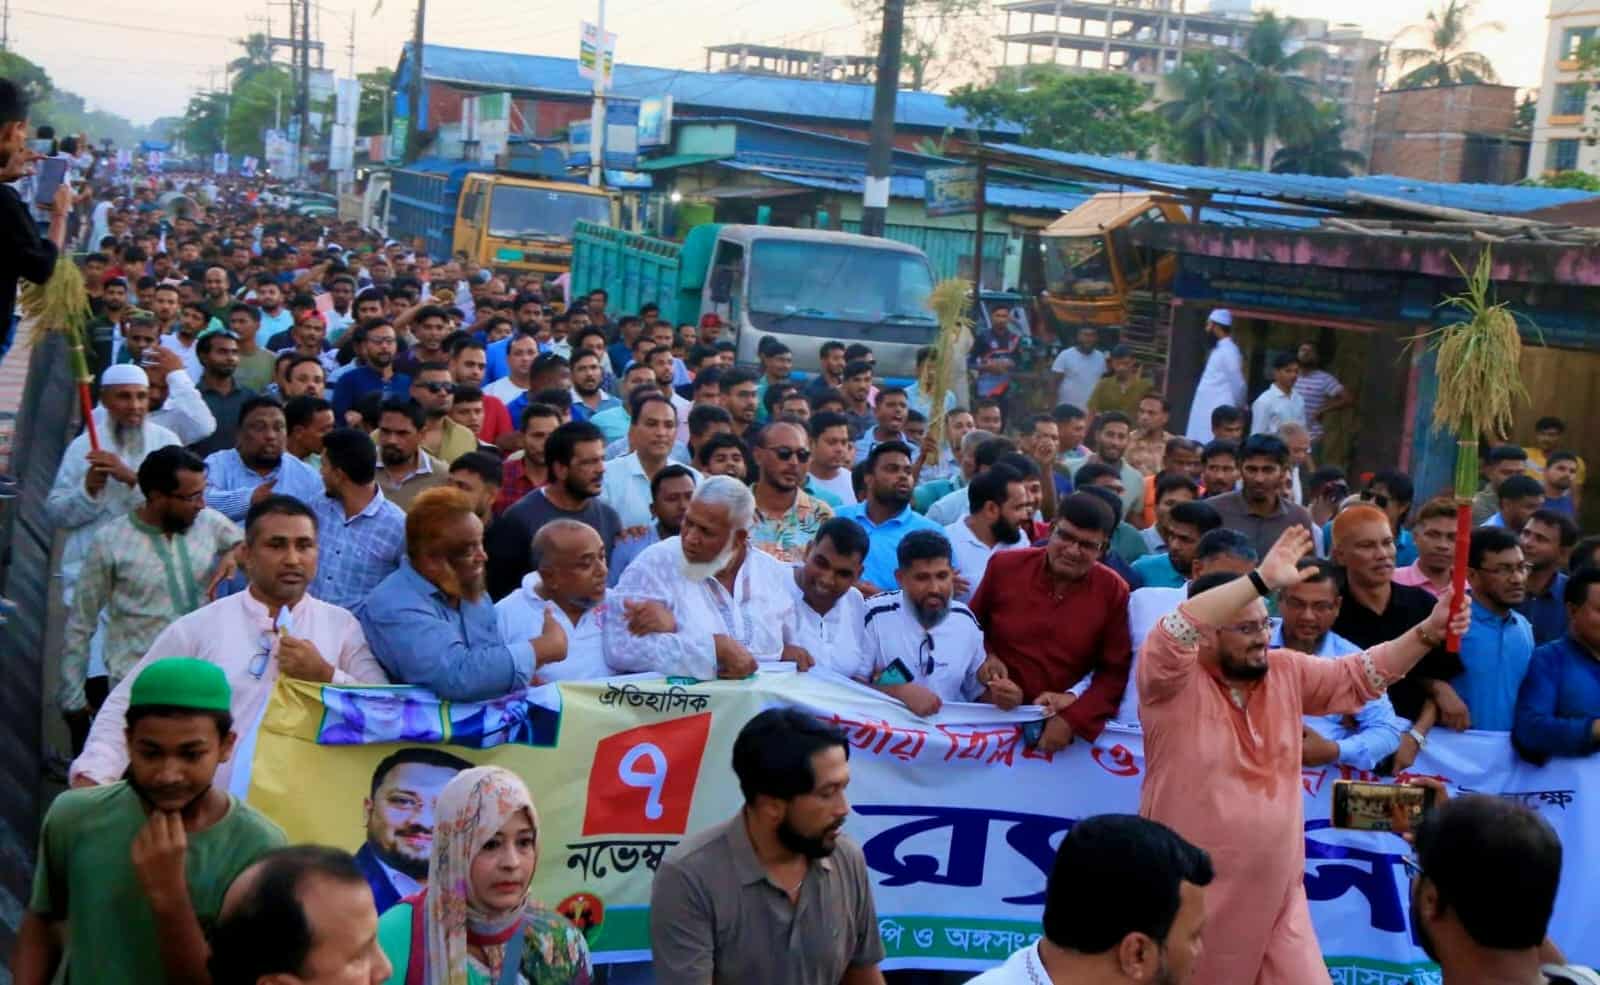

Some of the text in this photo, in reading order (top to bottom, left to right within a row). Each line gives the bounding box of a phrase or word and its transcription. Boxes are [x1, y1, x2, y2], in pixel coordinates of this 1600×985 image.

[599, 682, 711, 713] ঐতিহাসিক
[618, 742, 668, 821] ৭
[566, 840, 681, 882] নভেম্ব
[913, 928, 934, 948] ও
